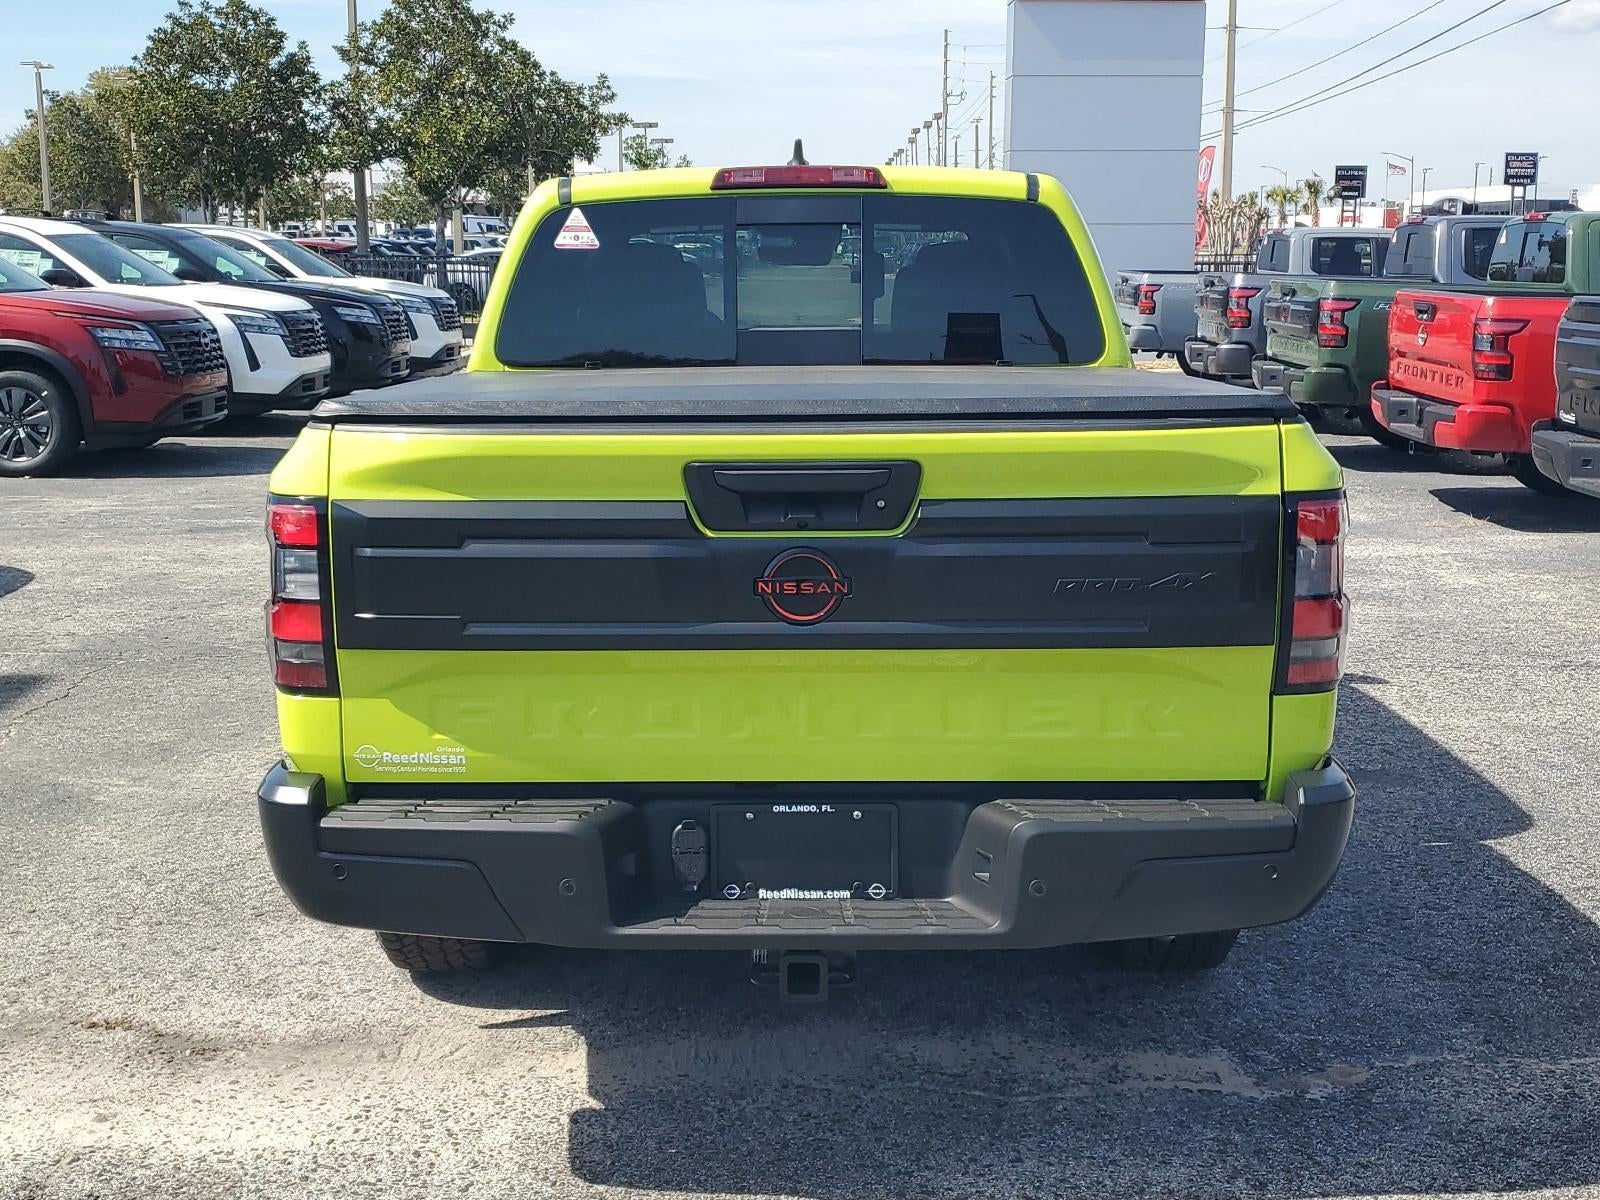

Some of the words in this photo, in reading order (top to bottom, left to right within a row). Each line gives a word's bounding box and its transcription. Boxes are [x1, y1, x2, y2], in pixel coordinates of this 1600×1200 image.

[1396, 360, 1464, 390] FRONTIER
[757, 581, 848, 594] NISSAN
[427, 694, 1183, 741] FRONTIER
[436, 745, 465, 753] Orlando
[772, 804, 820, 813] ORLANDO,
[821, 804, 836, 812] FL.
[758, 887, 851, 899] ReedNissan.com
